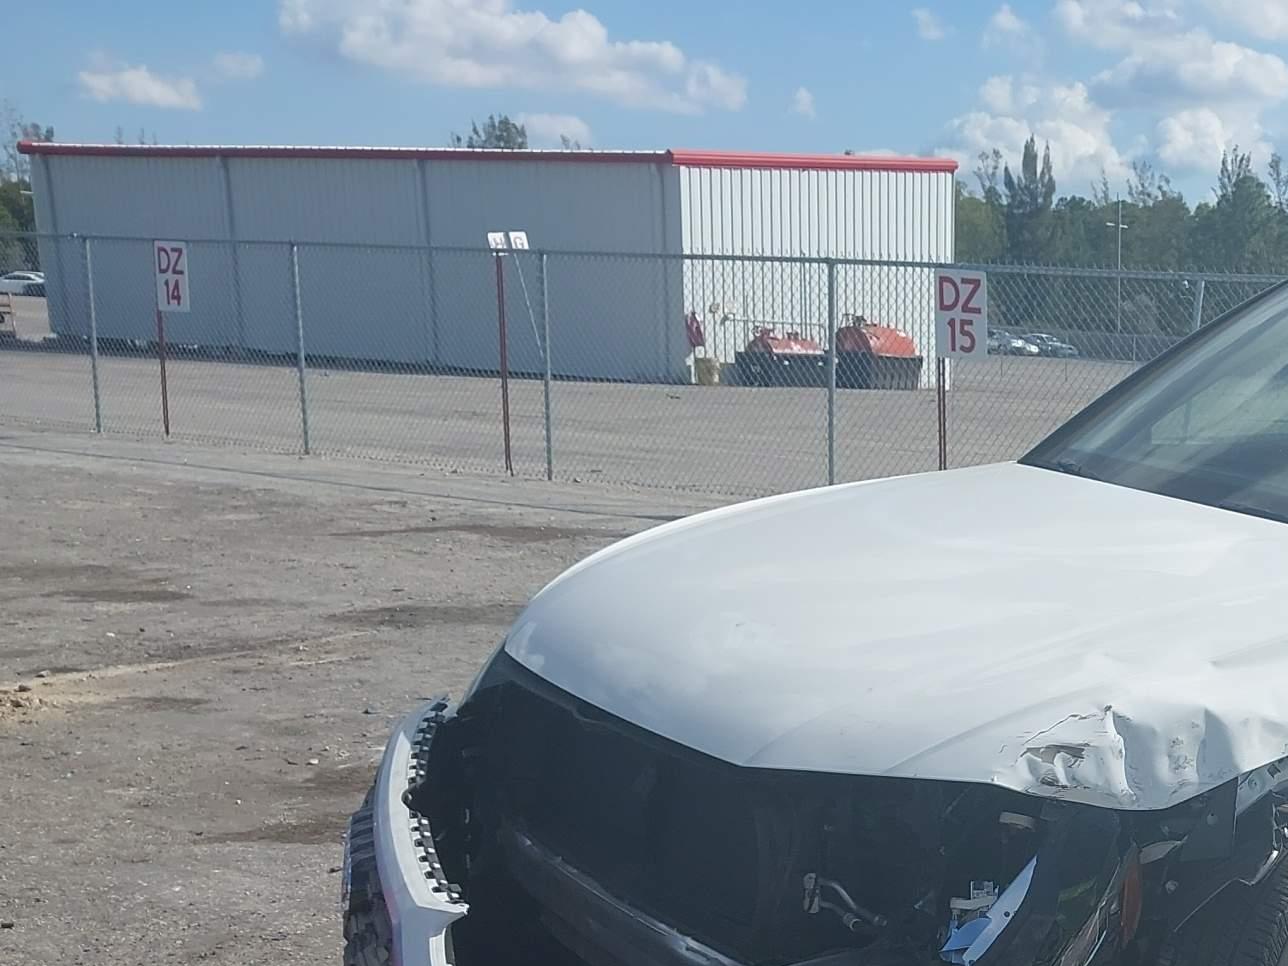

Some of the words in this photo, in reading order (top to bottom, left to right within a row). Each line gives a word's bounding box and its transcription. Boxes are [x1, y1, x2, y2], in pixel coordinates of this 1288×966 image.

[157, 246, 185, 275] DZ
[164, 278, 181, 307] 14
[939, 276, 982, 314] DZ
[947, 317, 976, 353] 15
